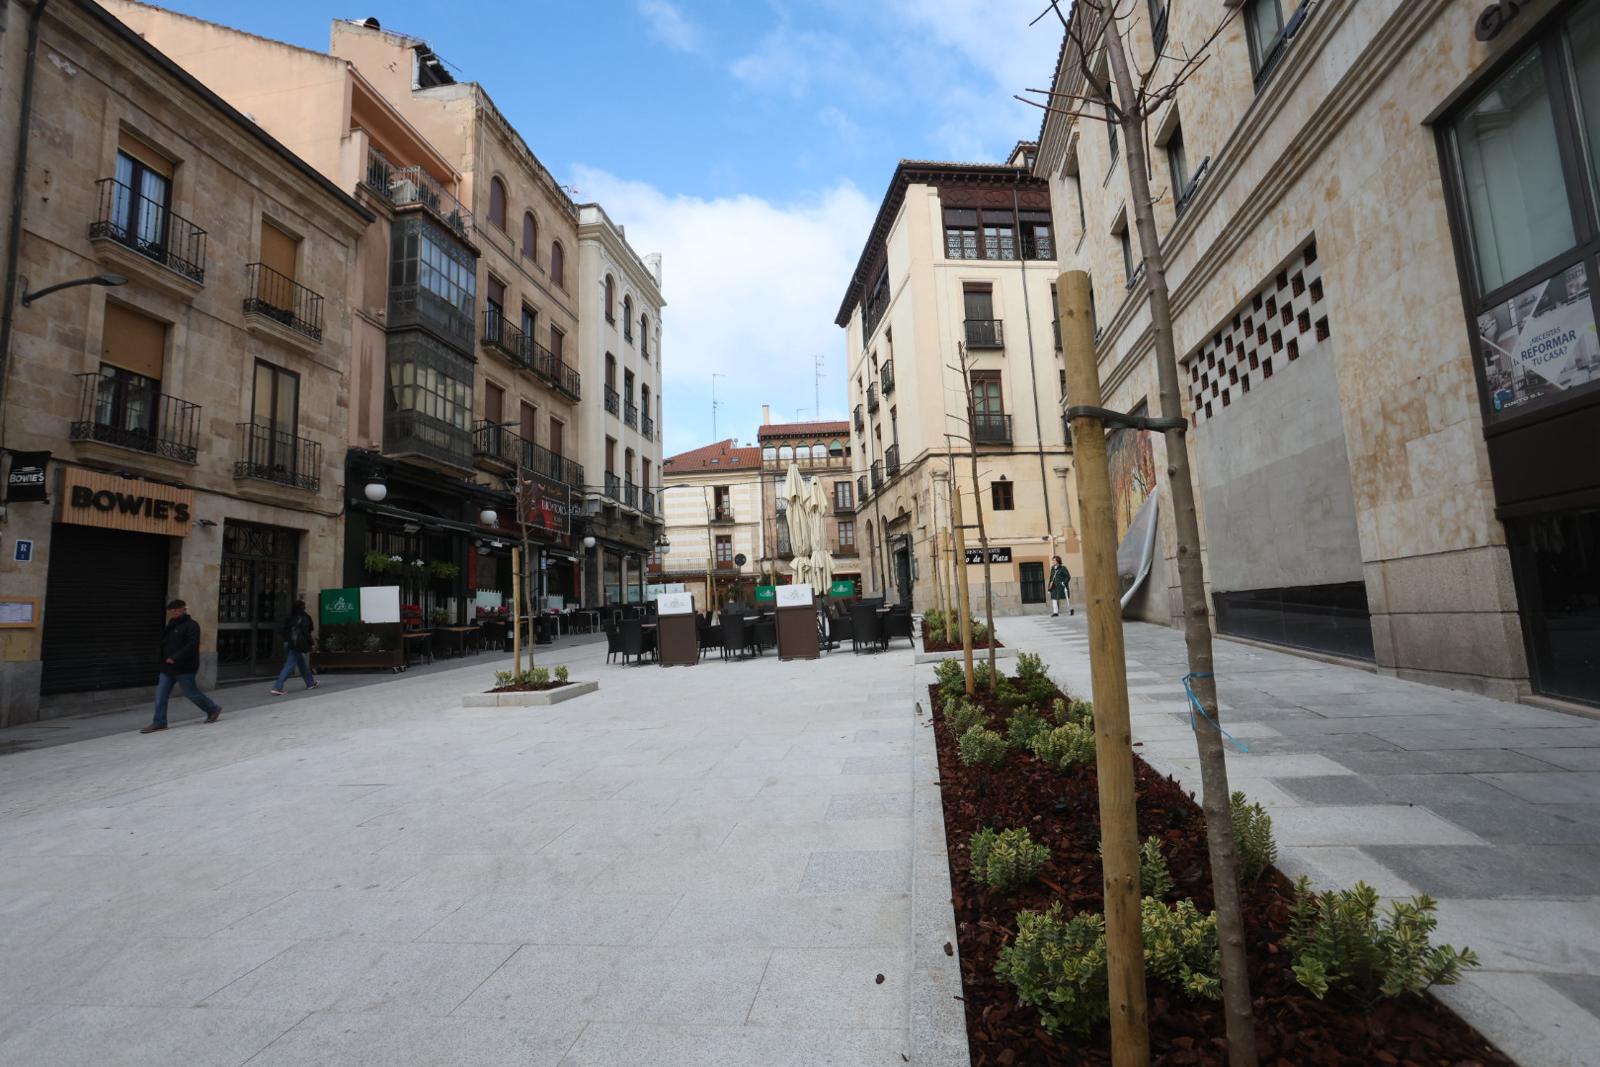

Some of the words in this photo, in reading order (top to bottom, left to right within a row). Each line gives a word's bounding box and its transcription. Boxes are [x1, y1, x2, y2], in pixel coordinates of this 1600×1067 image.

[1521, 330, 1576, 361] REFORMAR
[1532, 356, 1543, 366] TU
[1543, 346, 1568, 362] CASA?
[9, 472, 45, 483] BOWIE'S
[72, 485, 190, 522] BOWIE'S
